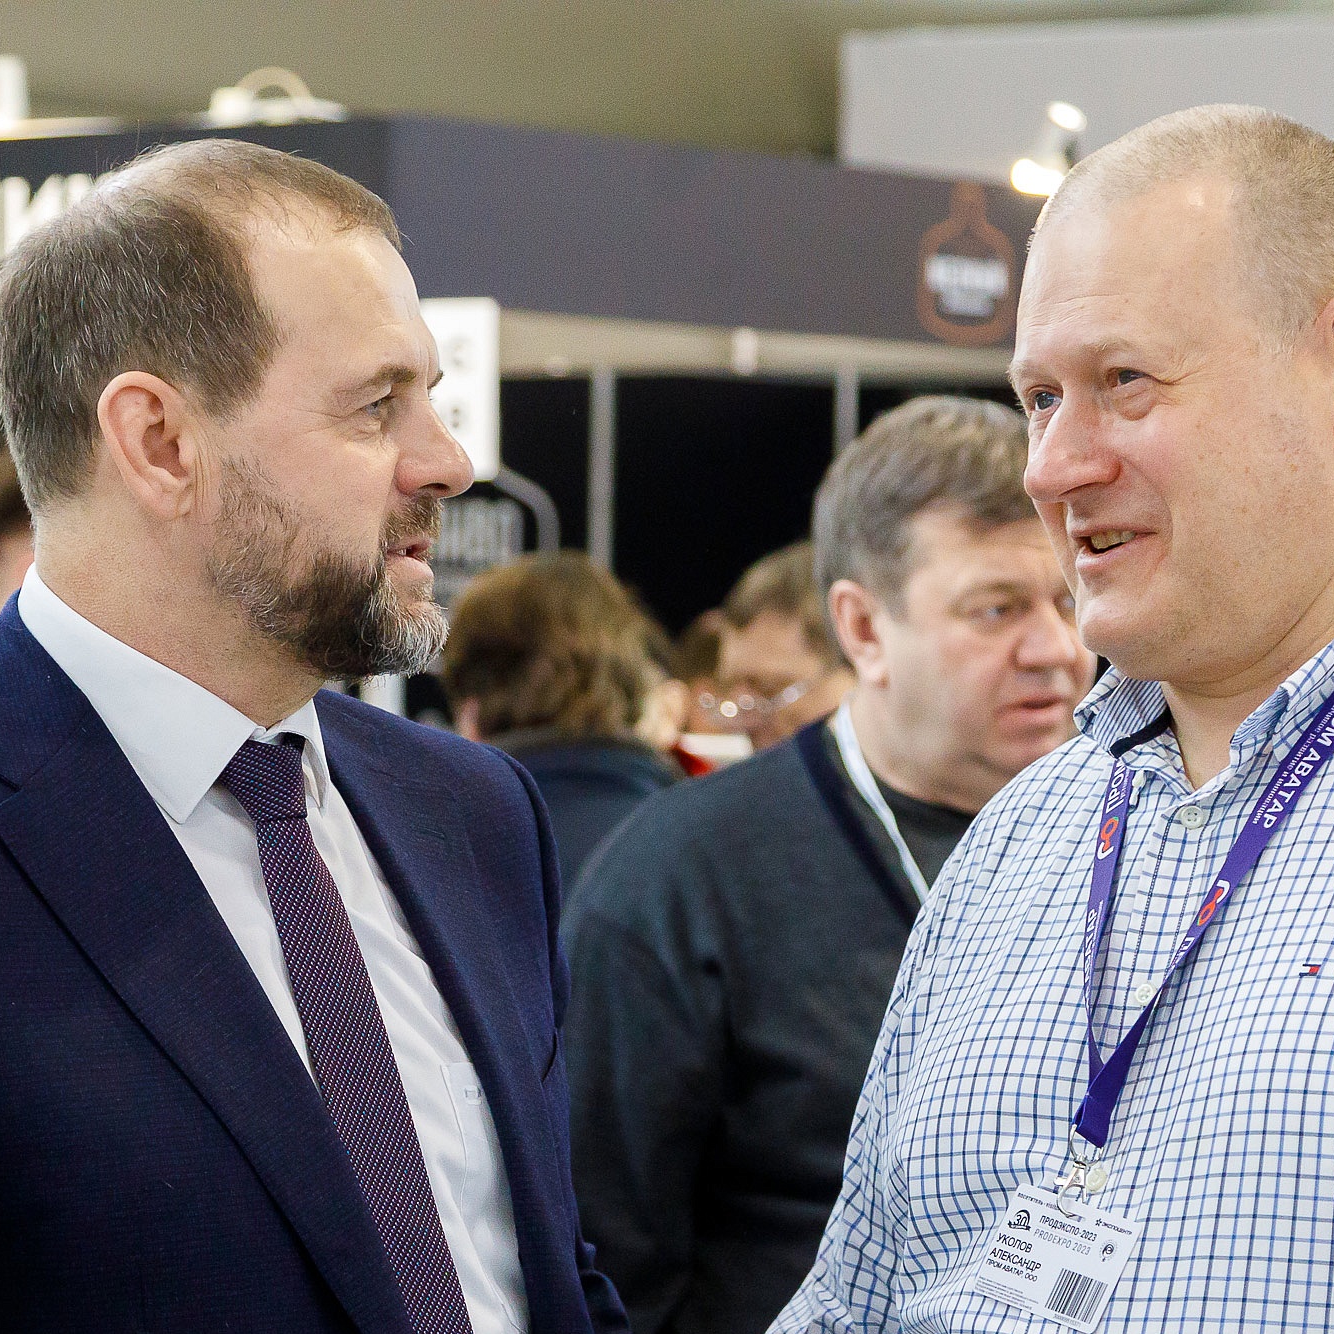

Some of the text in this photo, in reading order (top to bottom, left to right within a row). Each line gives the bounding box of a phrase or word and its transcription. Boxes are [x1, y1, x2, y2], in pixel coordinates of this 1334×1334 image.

[1263, 747, 1322, 829] АВАТАР
[1039, 1215, 1098, 1242] ПРОДЭКСПО-2023
[996, 1233, 1033, 1254] УКОЛОВ
[1033, 1228, 1091, 1256] PRODEXPO 2023
[986, 1258, 1003, 1271] ПРОМ
[990, 1248, 1042, 1273] АЛЕКСАНДР
